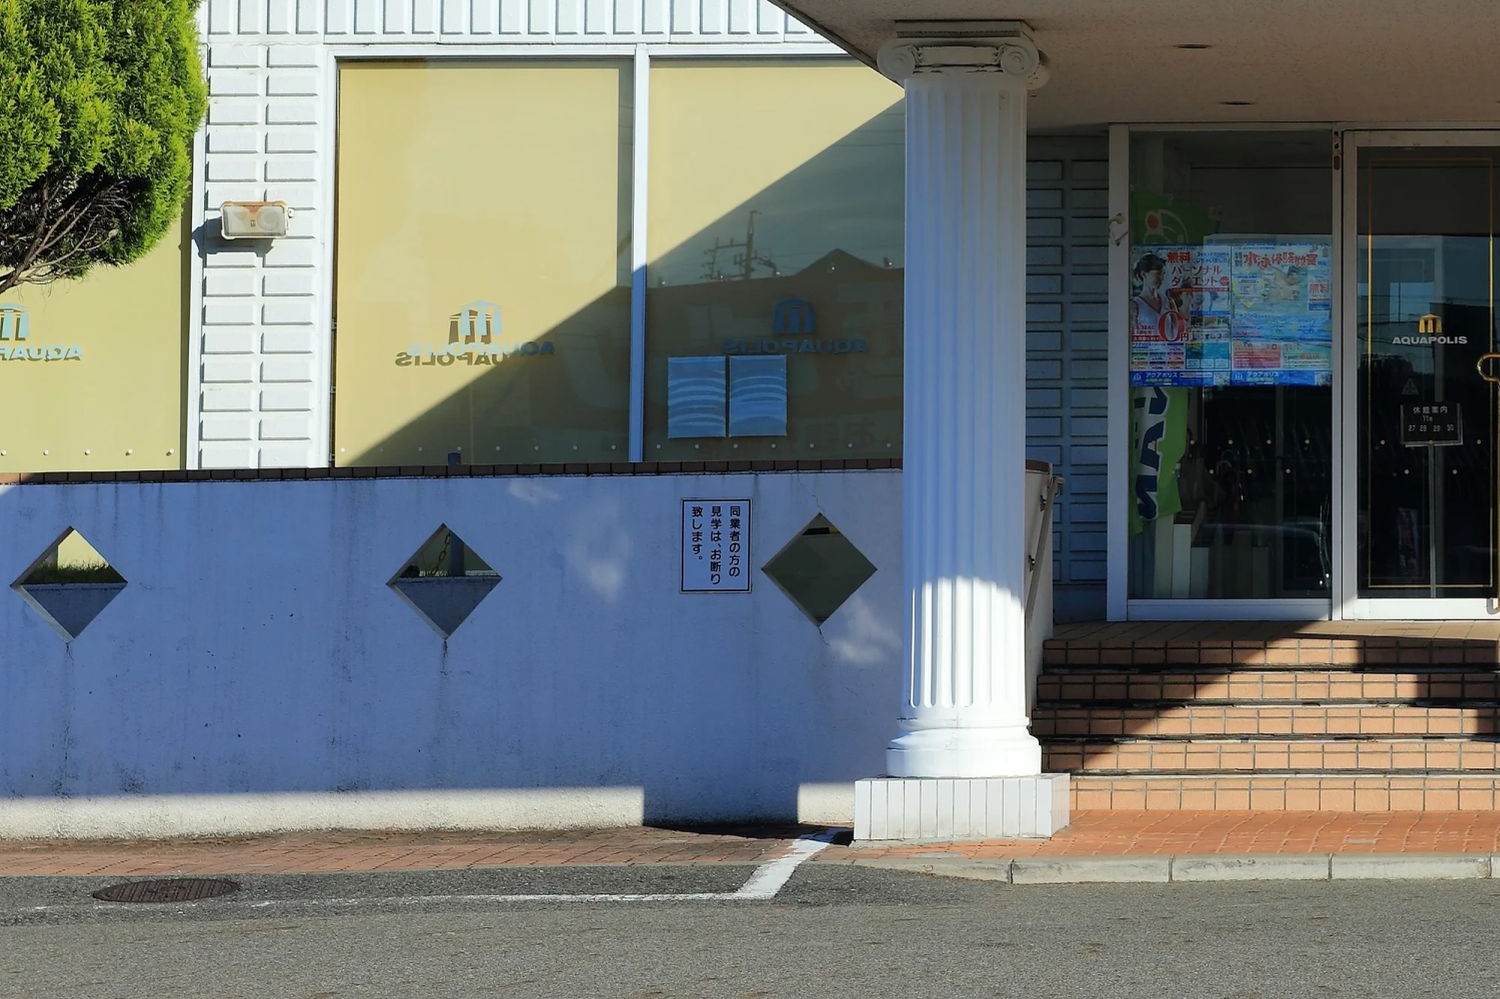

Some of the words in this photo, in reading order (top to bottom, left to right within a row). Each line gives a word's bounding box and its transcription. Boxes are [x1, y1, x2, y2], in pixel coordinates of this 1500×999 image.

[1171, 265, 1222, 275] パーソナル
[1171, 276, 1218, 286] ダイエット
[1391, 336, 1468, 345] AQUAPOLIS
[1412, 406, 1449, 415] 休館案内
[1408, 424, 1416, 432] 27
[691, 505, 703, 560] 致します。
[710, 505, 722, 585] 見学は、お断り
[729, 505, 741, 577] 同業者の方の
